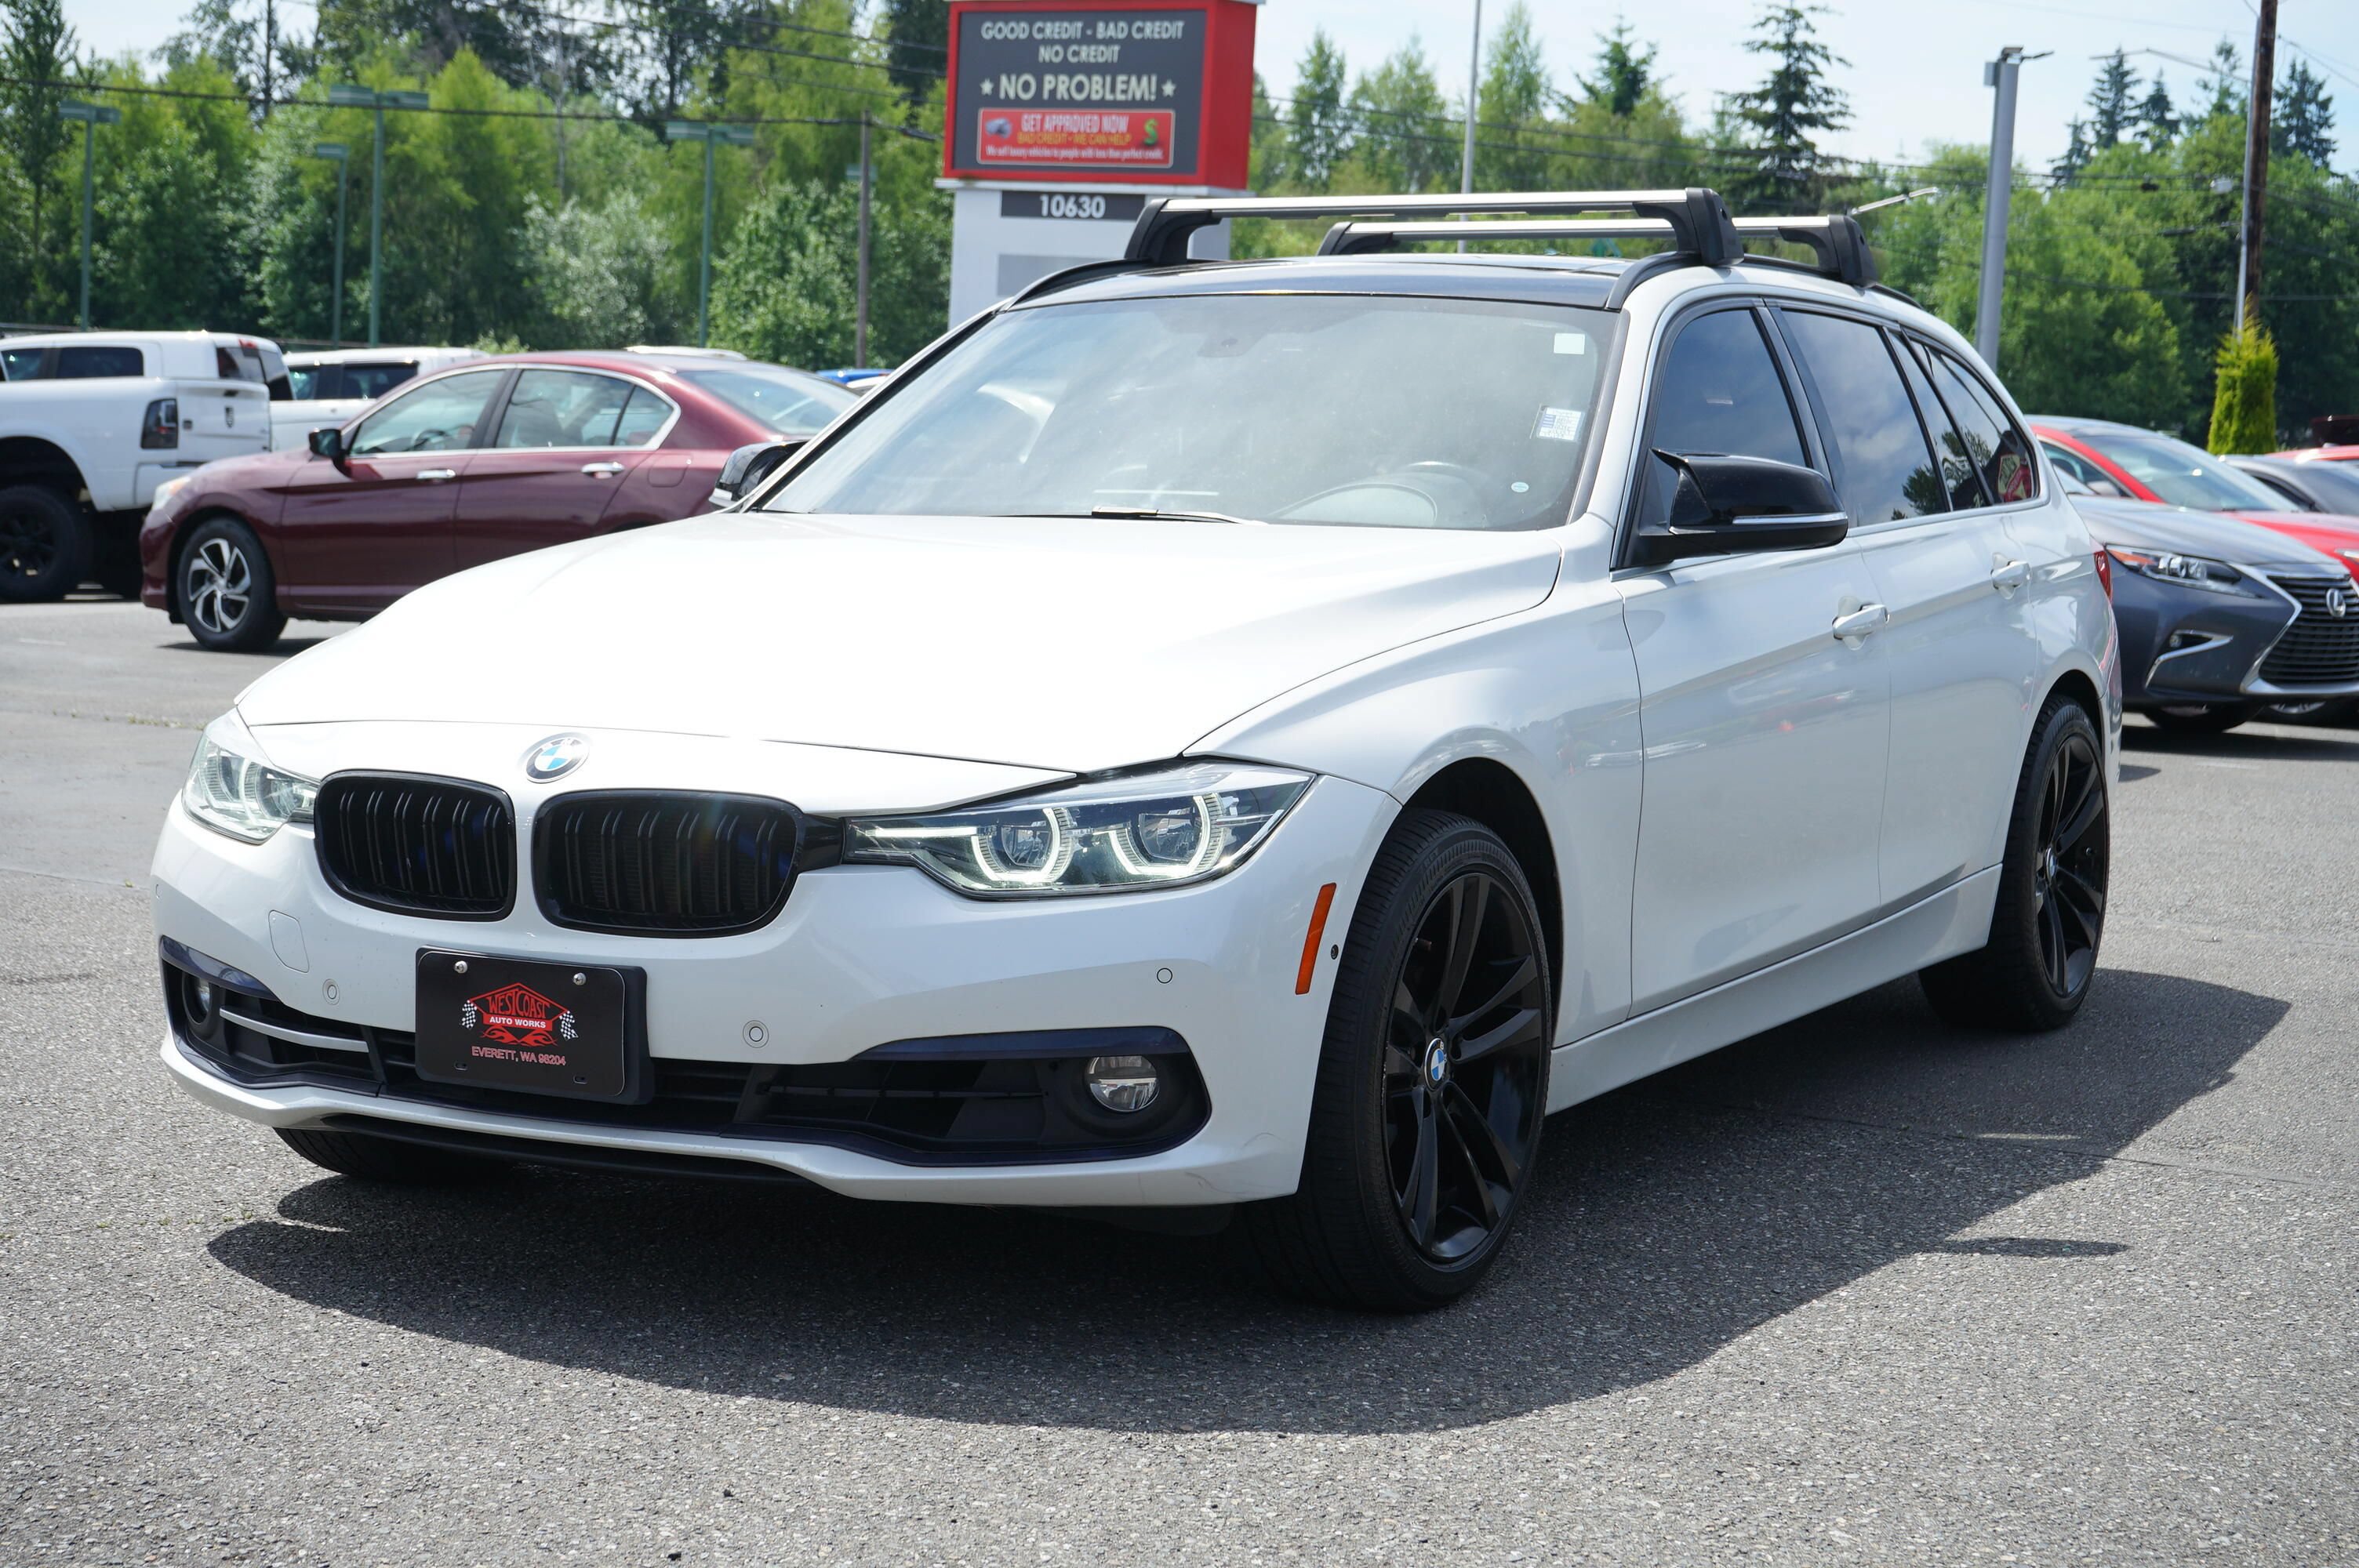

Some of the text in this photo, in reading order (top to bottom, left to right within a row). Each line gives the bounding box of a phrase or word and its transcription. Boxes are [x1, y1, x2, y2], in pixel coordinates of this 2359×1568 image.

[980, 20, 1030, 40] GOOD
[1031, 20, 1083, 40] CREDIT
[1096, 20, 1129, 39] BAD
[1131, 20, 1185, 39] CREDIT
[1038, 44, 1121, 64] NO CREDIT
[998, 73, 1158, 101] NO PROBLEM!
[1021, 113, 1129, 133] GET APPROVED NOW
[1037, 132, 1067, 145] CREDIT
[1039, 194, 1106, 219] 10630
[489, 1016, 546, 1029] AUTO WORKS
[471, 1045, 566, 1066] EVERETT, WA 98204
